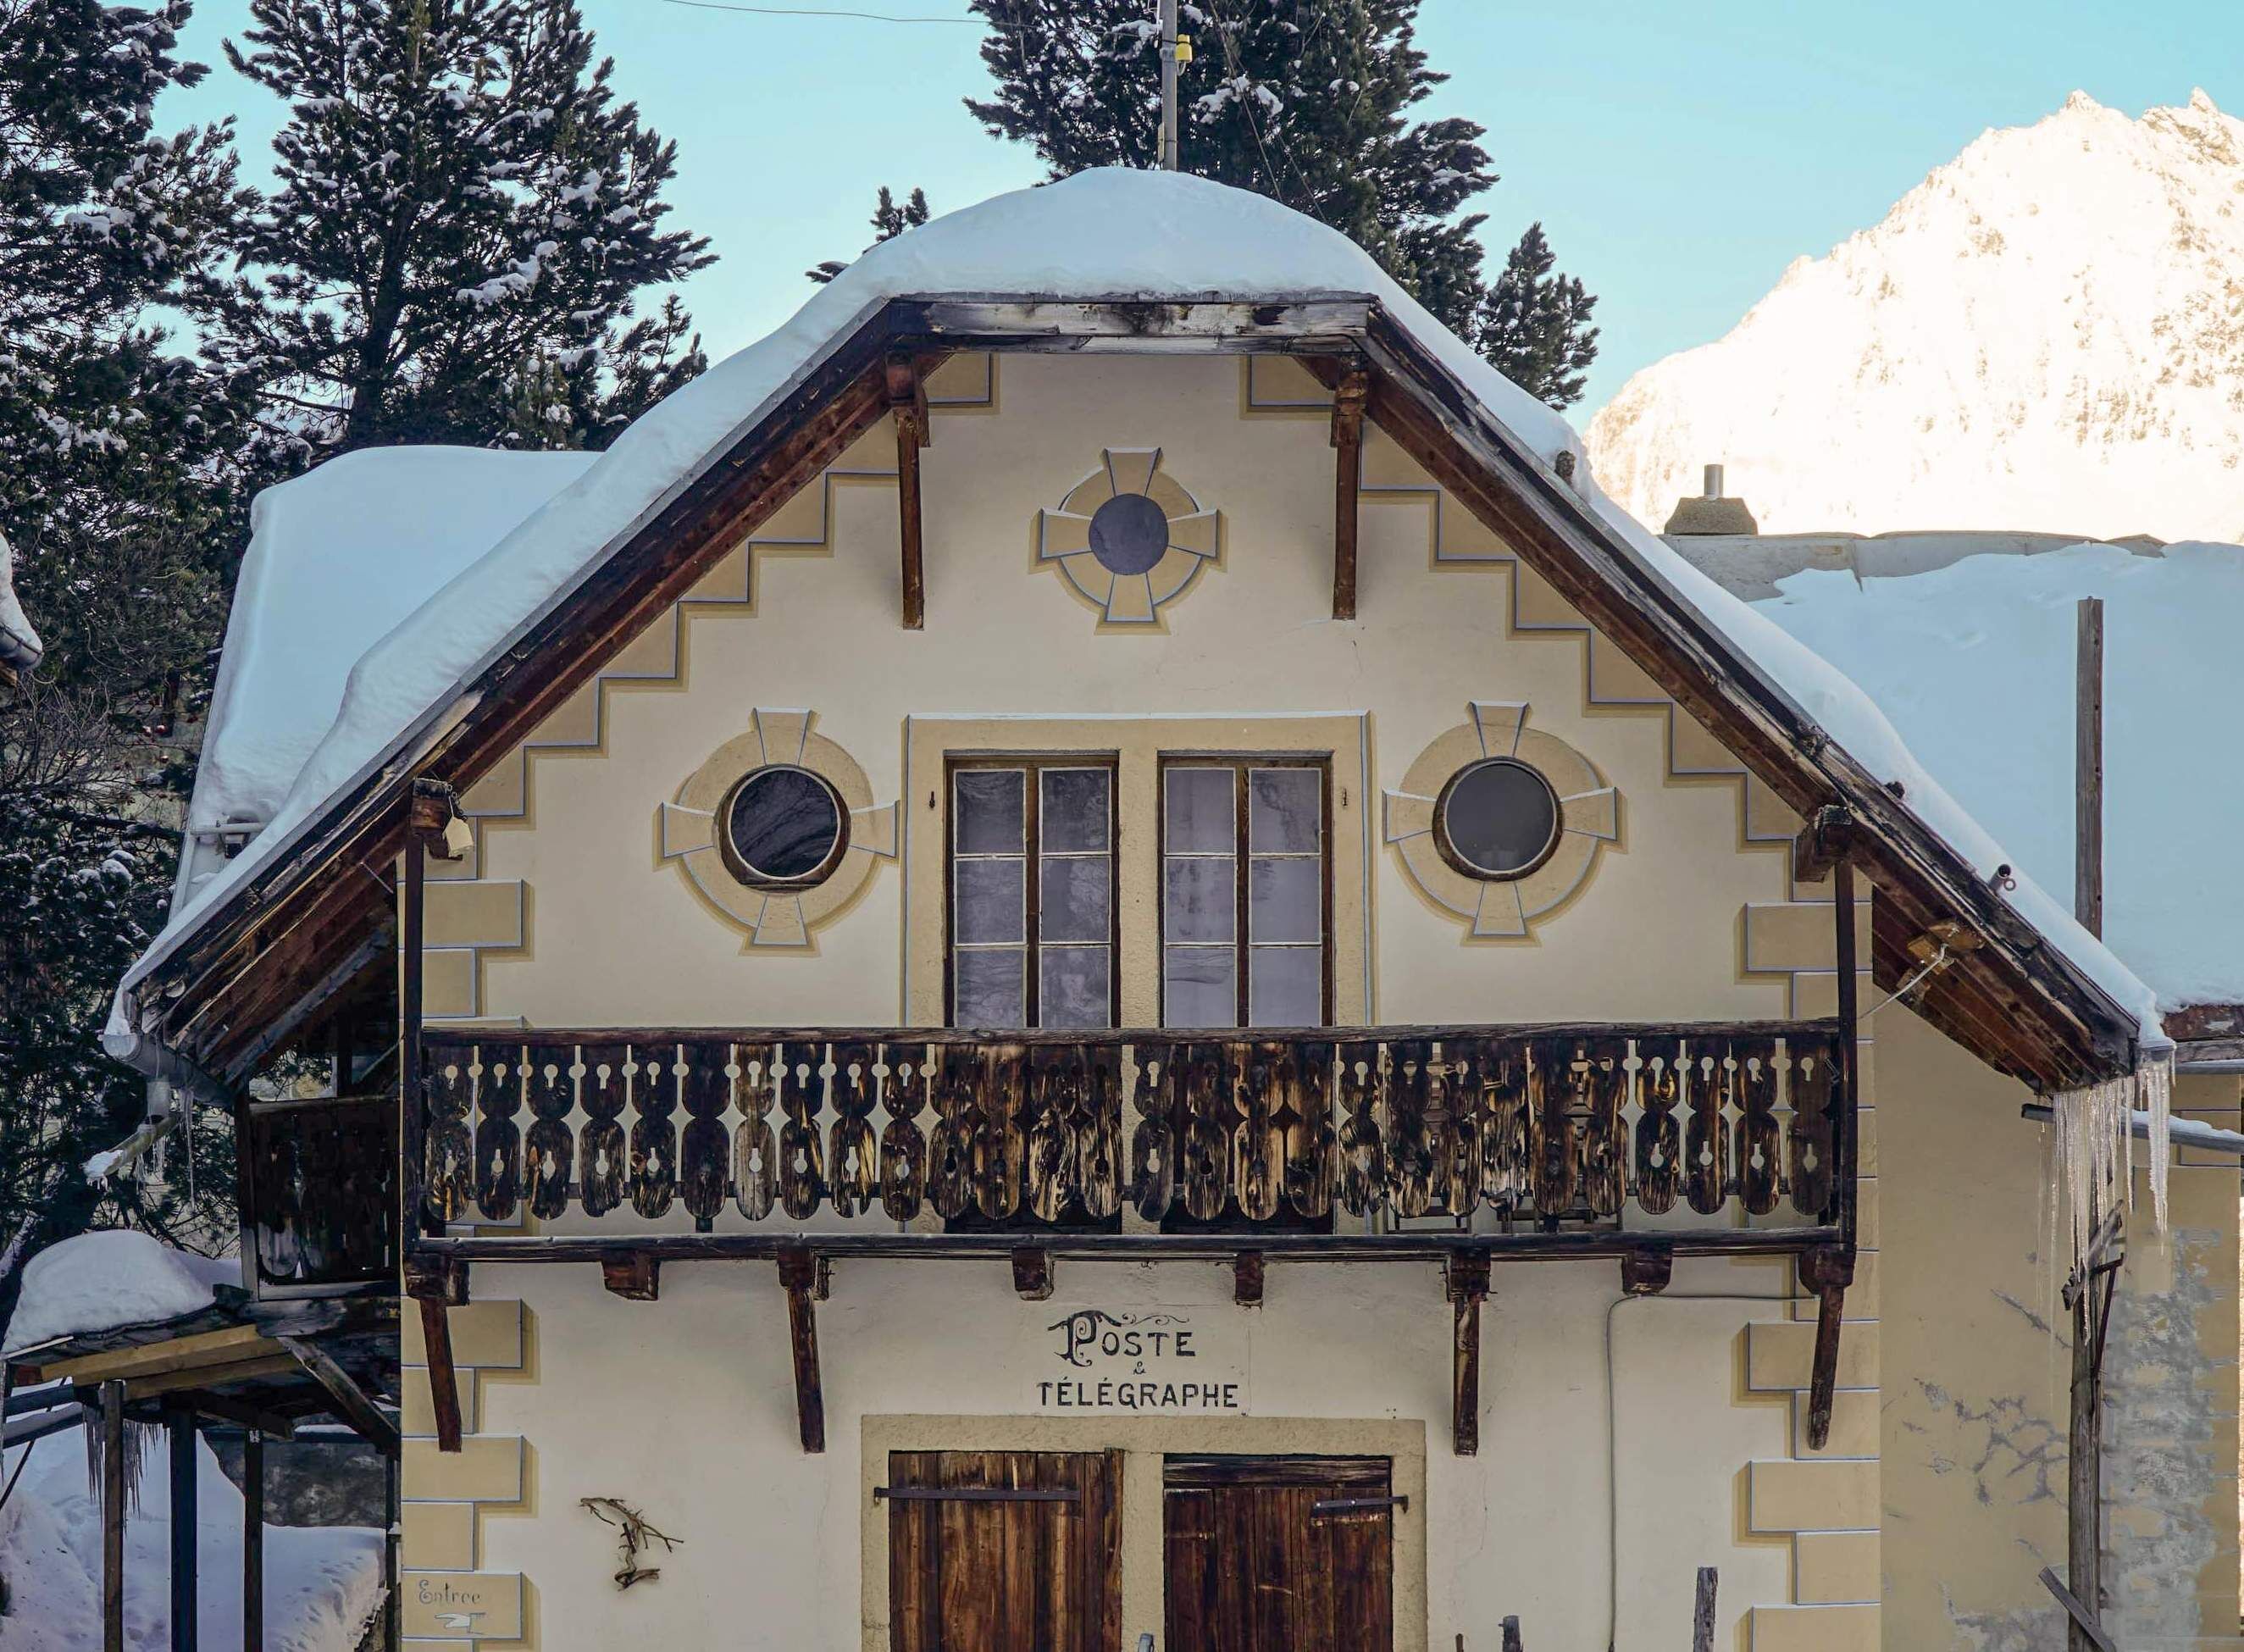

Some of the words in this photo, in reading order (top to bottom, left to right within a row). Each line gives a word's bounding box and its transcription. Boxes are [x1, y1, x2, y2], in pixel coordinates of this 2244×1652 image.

[1049, 1310, 1195, 1367] POSTE
[1133, 1361, 1145, 1374] &
[1037, 1377, 1238, 1409] TÉLÉGRAPHE
